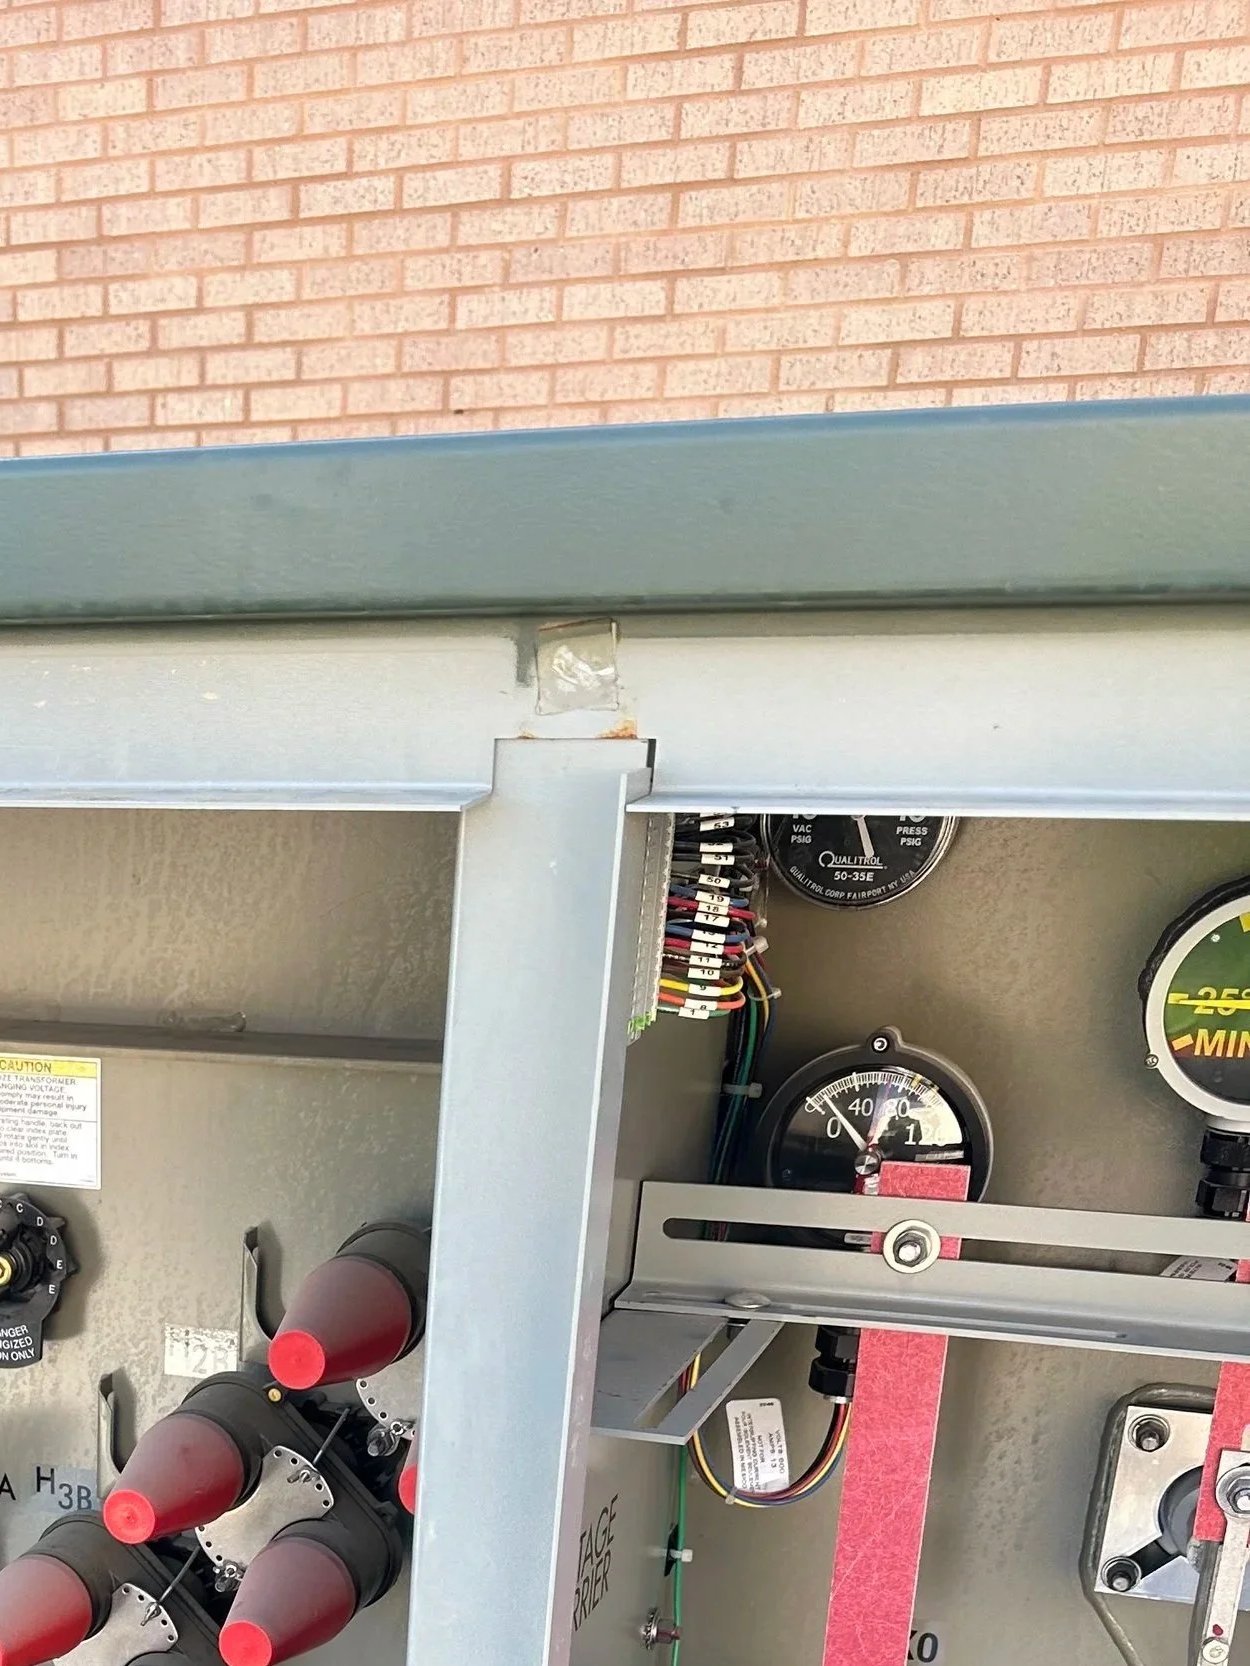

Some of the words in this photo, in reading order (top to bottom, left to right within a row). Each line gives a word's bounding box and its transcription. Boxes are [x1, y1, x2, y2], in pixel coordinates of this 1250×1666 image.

[793, 825, 812, 833] VAC
[896, 827, 928, 835] PRESS
[791, 835, 812, 843] PSIG
[900, 838, 921, 846] PSIG
[819, 851, 883, 869] QUALITROL
[834, 871, 874, 882] 50-35E
[790, 866, 824, 895] QUALITROL
[847, 887, 886, 900] FAIRPORT
[888, 880, 898, 890] NY
[901, 870, 917, 883] USA
[0, 1059, 52, 1072] CAUTION
[15, 1075, 76, 1085] TRANSFORMER
[26, 1093, 40, 1101] may
[43, 1092, 64, 1101] result
[30, 1100, 63, 1110] personal
[66, 1102, 86, 1111] injury
[848, 1098, 873, 1116] 40
[886, 1099, 910, 1118] 80
[50, 1121, 67, 1129] back
[70, 1122, 82, 1130] out
[826, 1117, 842, 1138] 0
[16, 1204, 24, 1213] C
[37, 1217, 43, 1226] D
[50, 1236, 57, 1245] D
[57, 1260, 63, 1269] E
[49, 1285, 55, 1294] E
[11, 1348, 35, 1361] ONLY
[734, 1417, 743, 1454] ASSEMBLED
[775, 1429, 783, 1454] VOLTS
[36, 1466, 92, 1510] H3B
